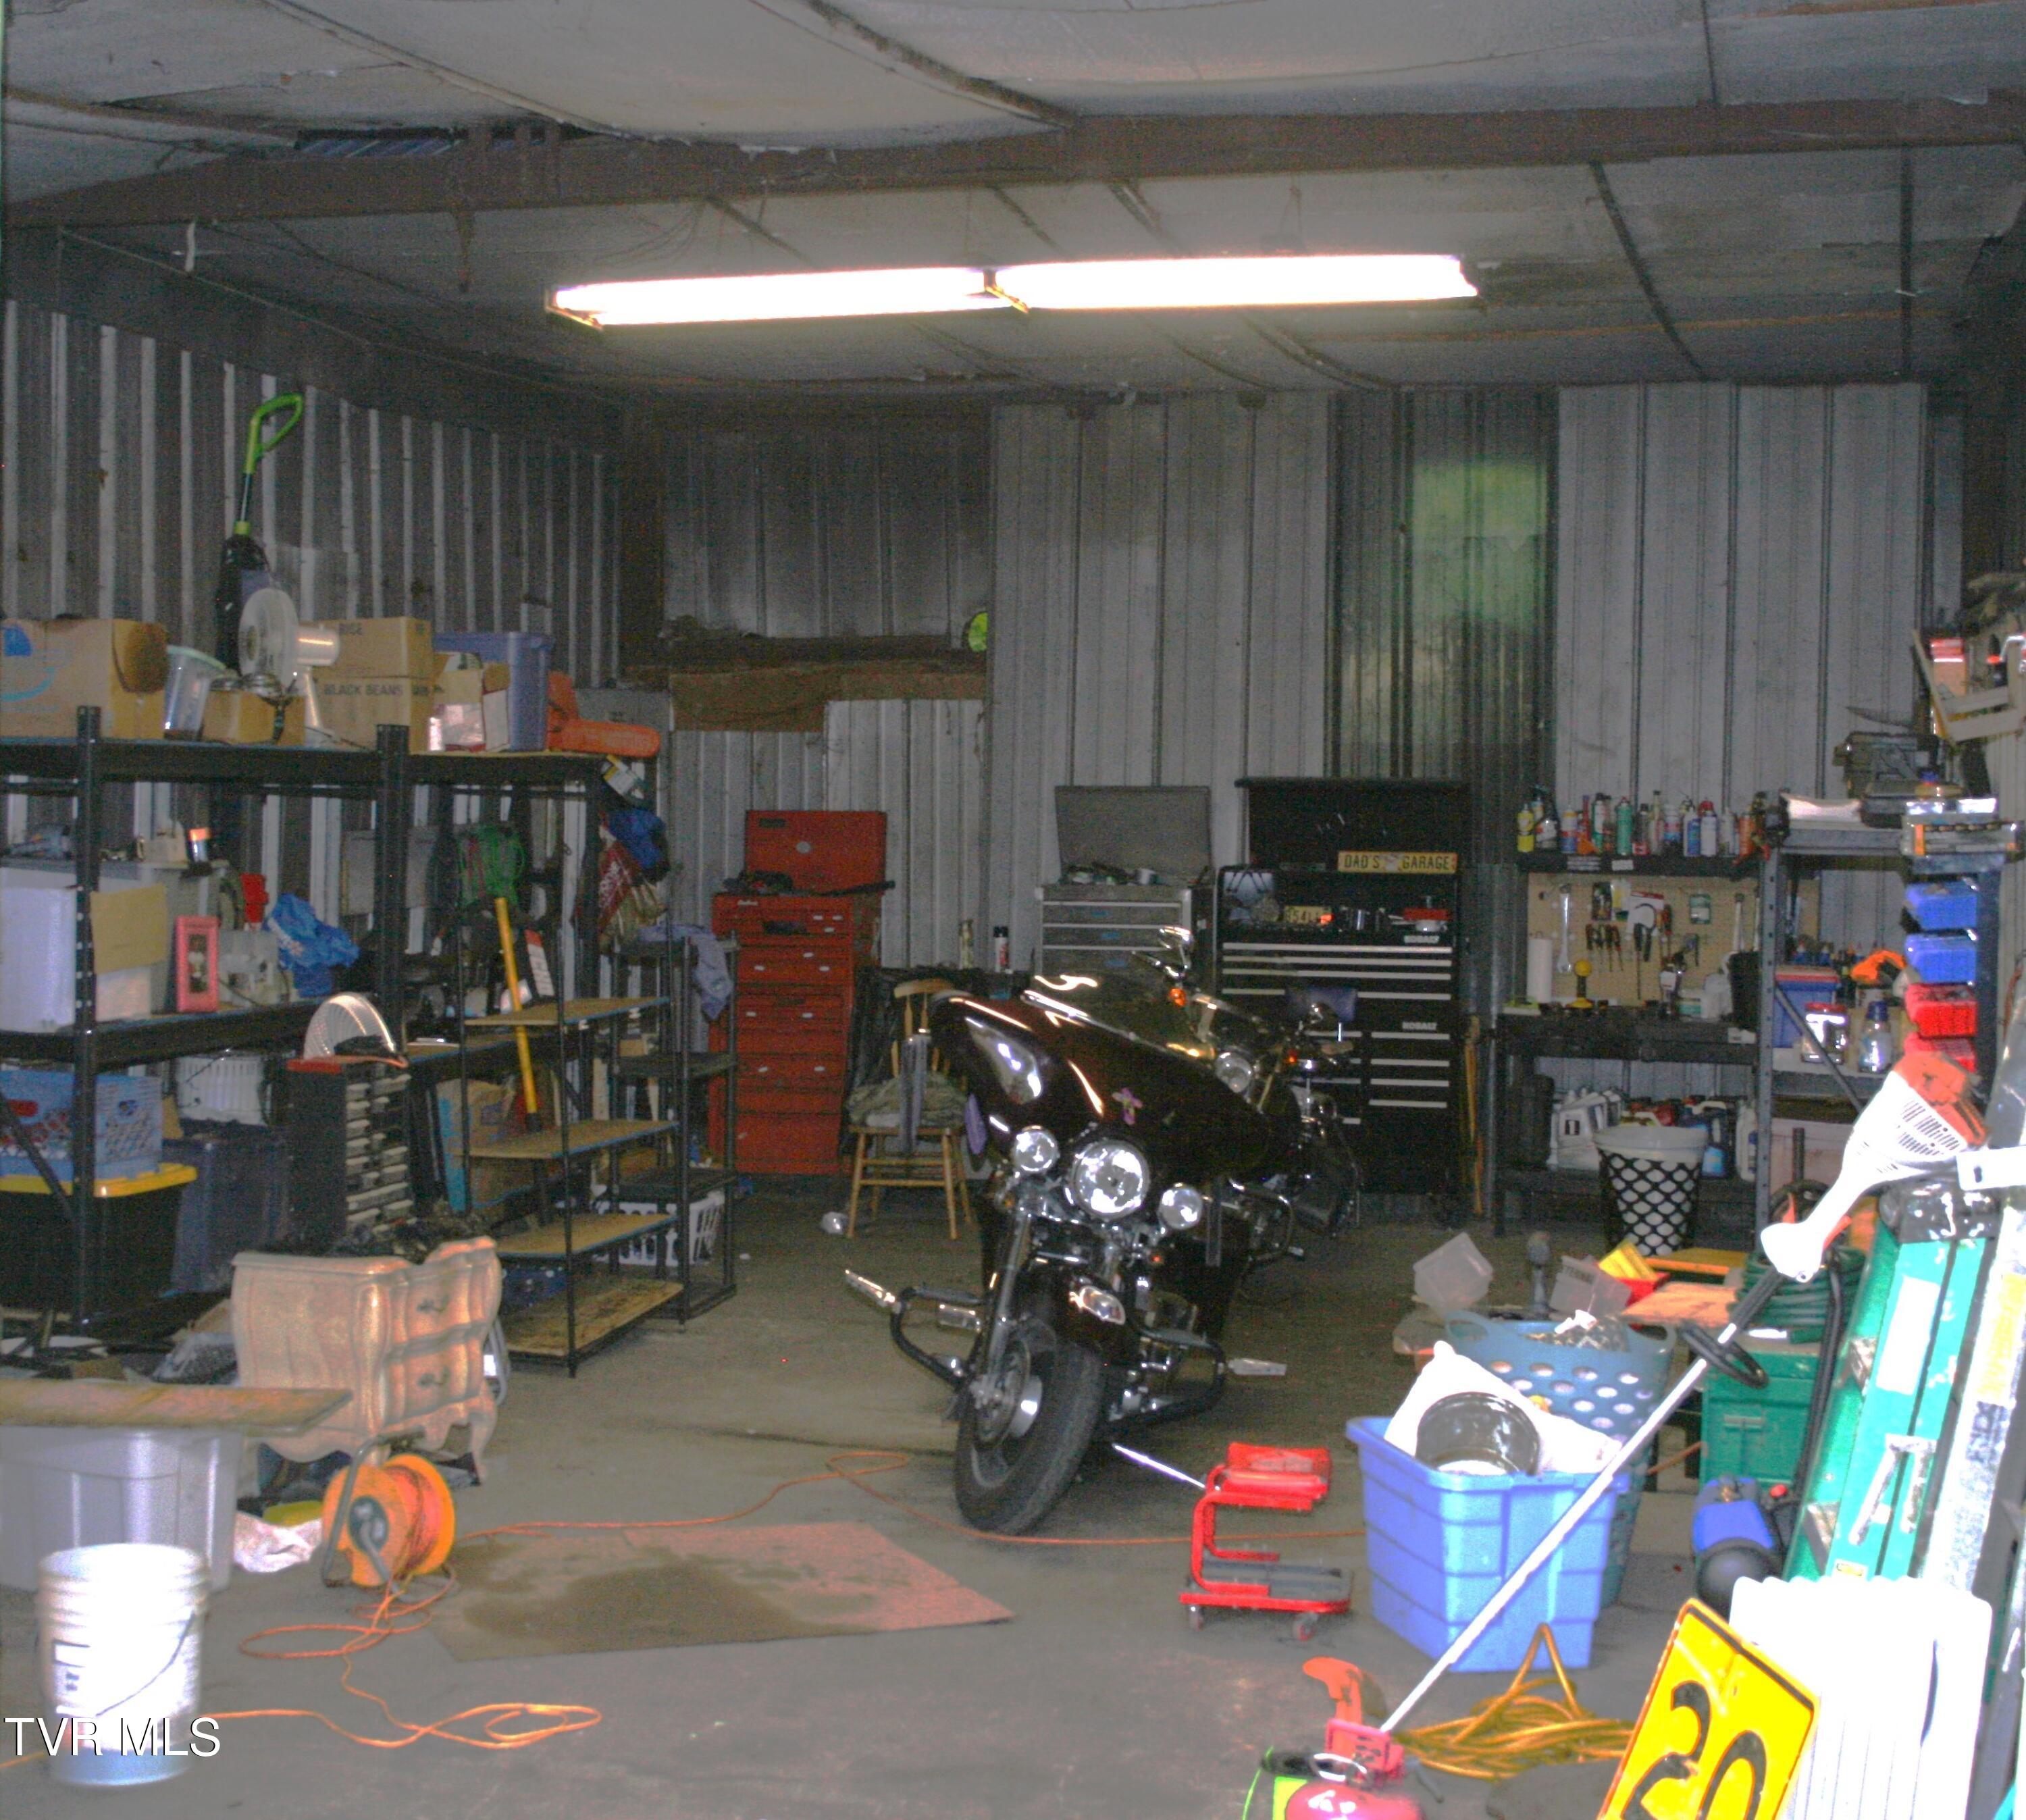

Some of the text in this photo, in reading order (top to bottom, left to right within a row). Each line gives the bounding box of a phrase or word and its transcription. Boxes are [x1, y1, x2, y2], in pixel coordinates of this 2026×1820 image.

[323, 684, 361, 696] BLACK
[365, 683, 404, 696] BEANS
[1344, 854, 1449, 870] DAD'S GARAGE
[1620, 1680, 1767, 1820] 20
